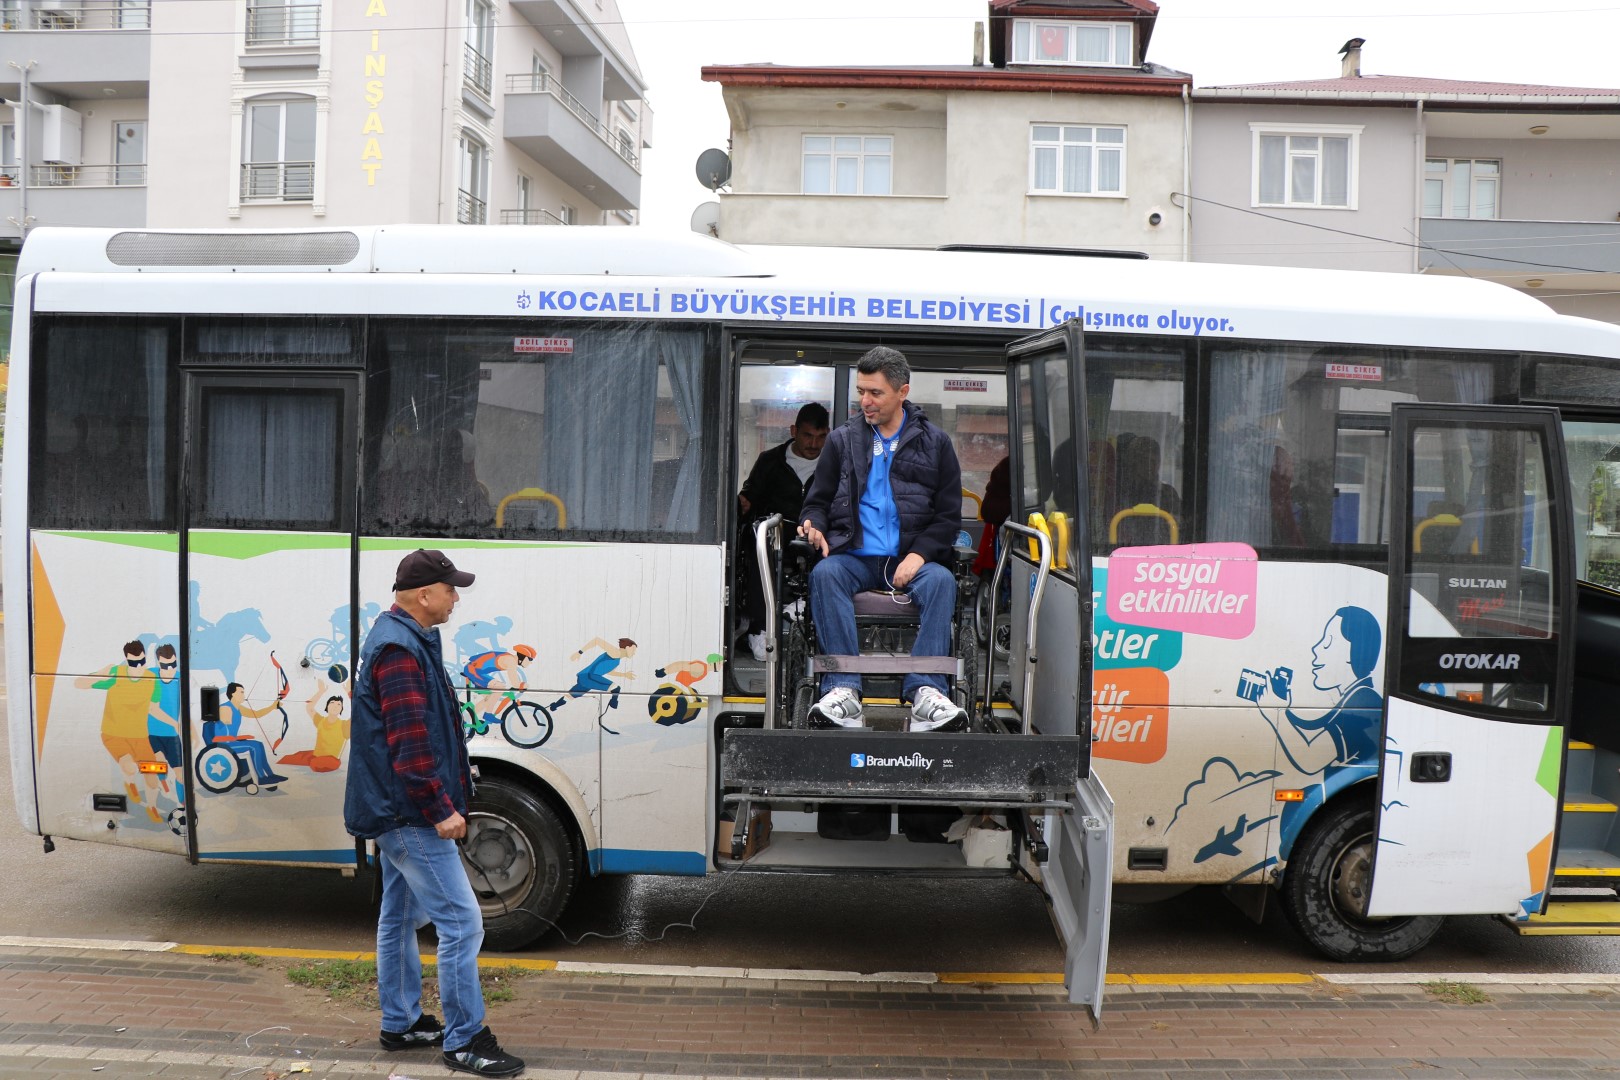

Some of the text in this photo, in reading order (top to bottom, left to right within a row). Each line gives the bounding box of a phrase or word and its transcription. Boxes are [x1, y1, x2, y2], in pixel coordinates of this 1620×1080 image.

[361, 29, 386, 187] İNŞAAT
[538, 287, 661, 313] KOCAELİ
[670, 288, 856, 321] BÜYÜKŞEHİR
[867, 296, 1031, 324] BELEDİYESİ
[1156, 309, 1235, 336] oluyor.
[1133, 560, 1222, 590] sosyal
[1448, 577, 1507, 589] SULTAN
[1118, 588, 1249, 614] etkinlikler
[1438, 653, 1521, 670] OTOKAR
[866, 752, 934, 770] BraunAbility
